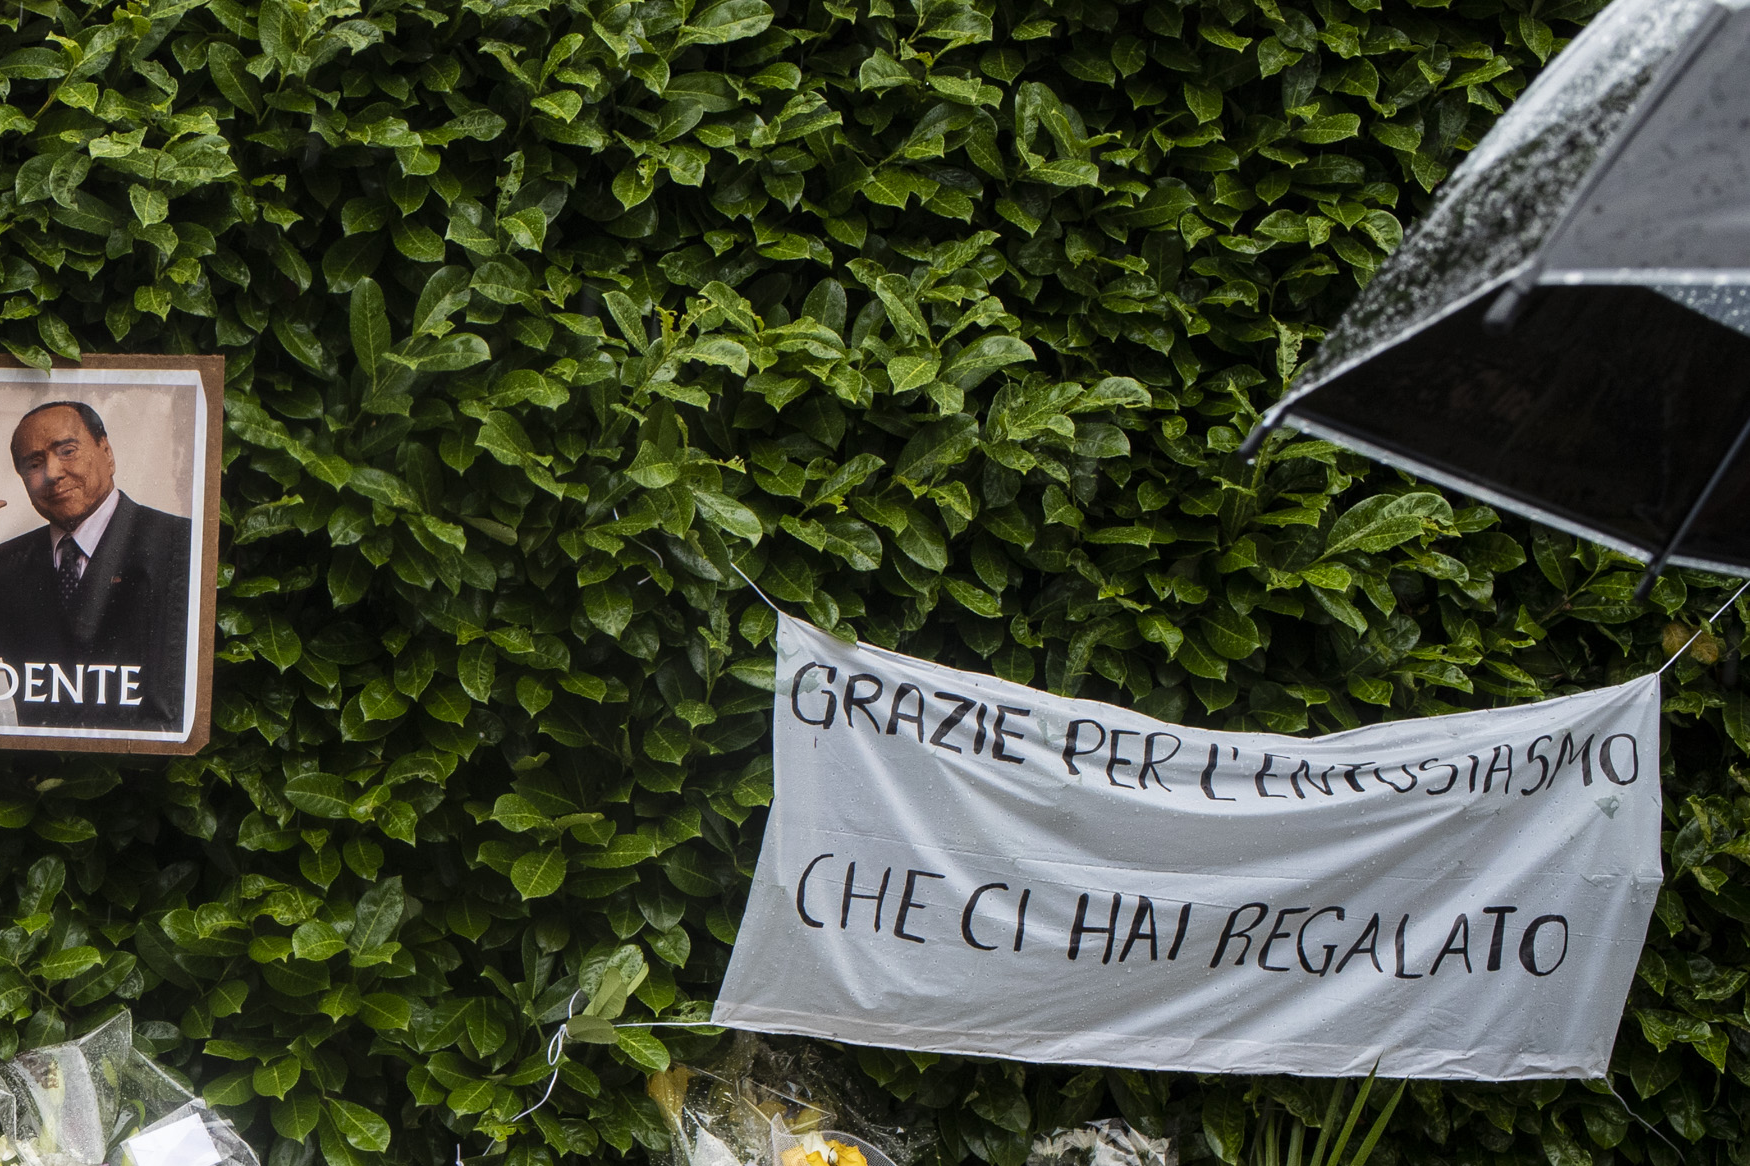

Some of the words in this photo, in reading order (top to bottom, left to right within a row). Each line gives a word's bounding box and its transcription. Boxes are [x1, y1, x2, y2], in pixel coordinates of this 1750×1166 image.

[791, 662, 1036, 765] GRAZIE
[1062, 719, 1180, 791] PER
[1202, 731, 1638, 801] L'ENTUSIASMO
[796, 853, 947, 944] CHE
[961, 882, 1030, 953] CI
[1067, 893, 1190, 964] HAI
[1210, 902, 1568, 981] REGALATO
